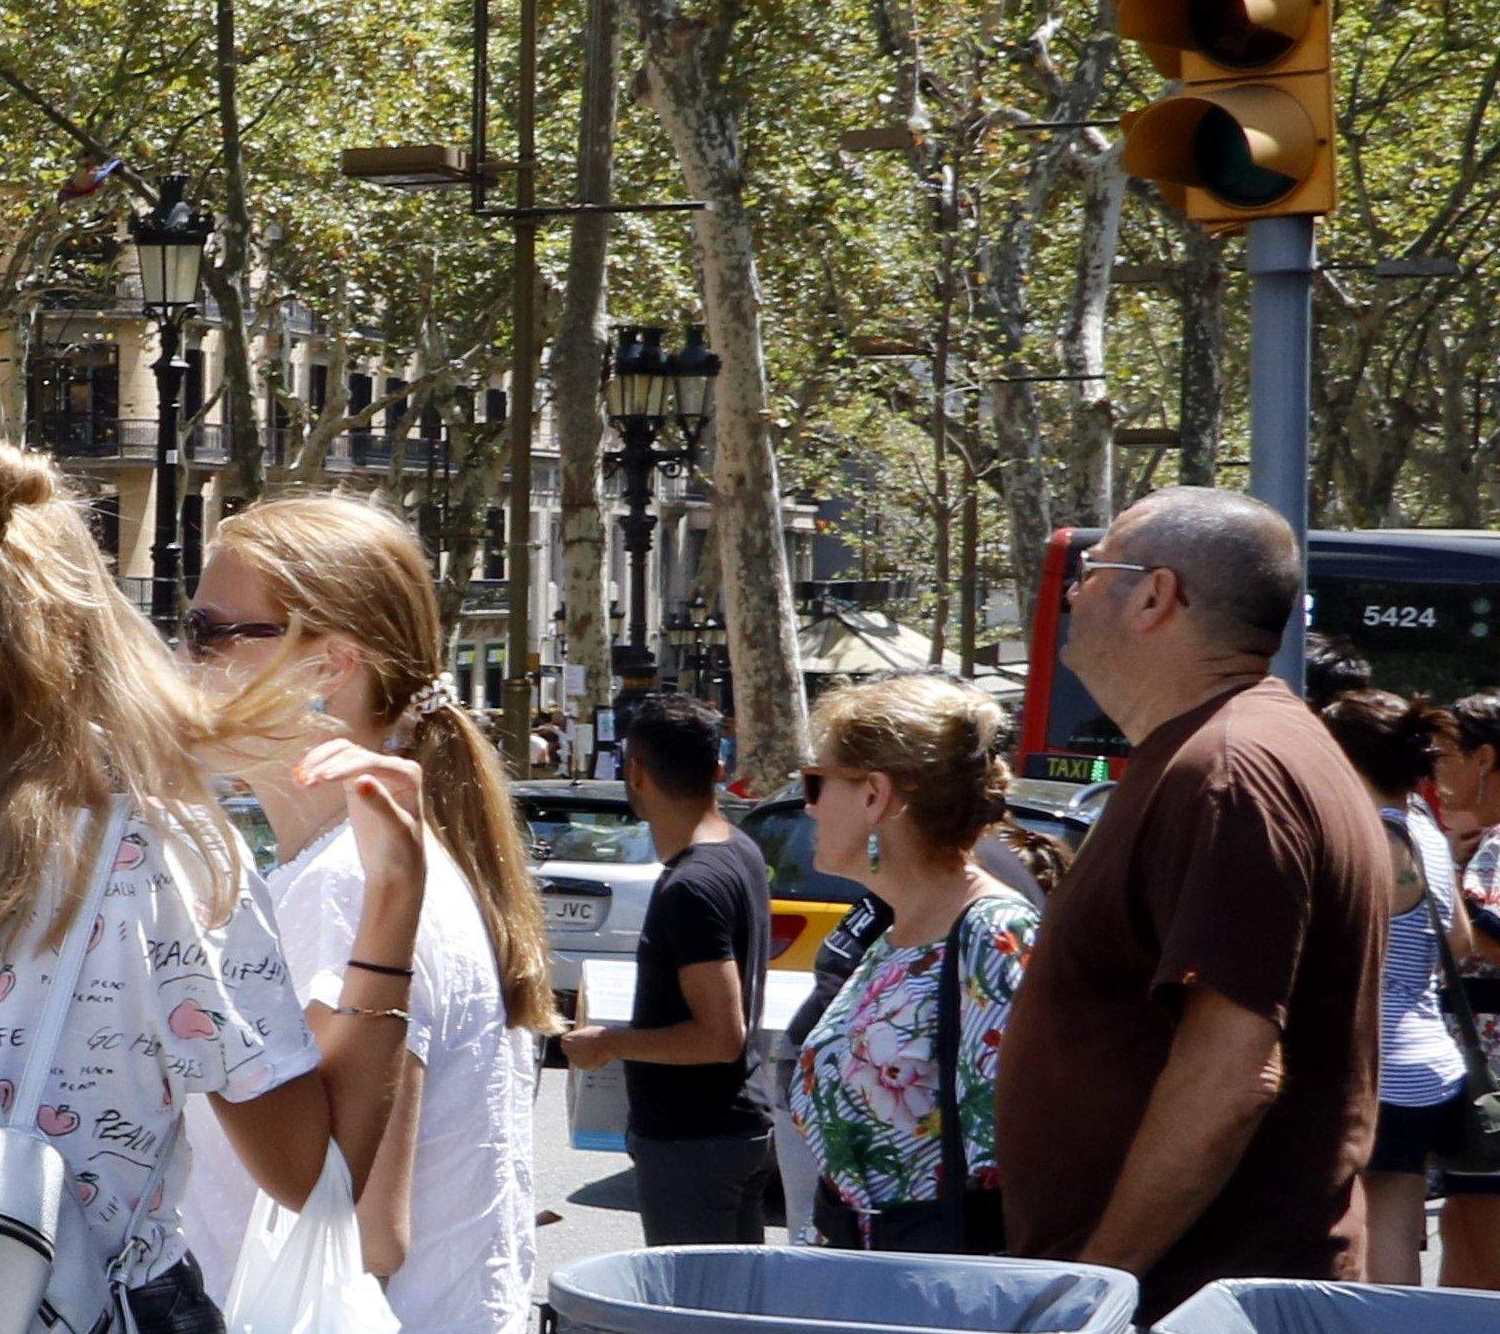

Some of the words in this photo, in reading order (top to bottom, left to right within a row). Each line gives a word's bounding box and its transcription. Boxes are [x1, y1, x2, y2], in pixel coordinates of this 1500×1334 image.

[1362, 605, 1437, 628] 5424
[1047, 757, 1092, 778] TAXI
[556, 903, 593, 919] JVC
